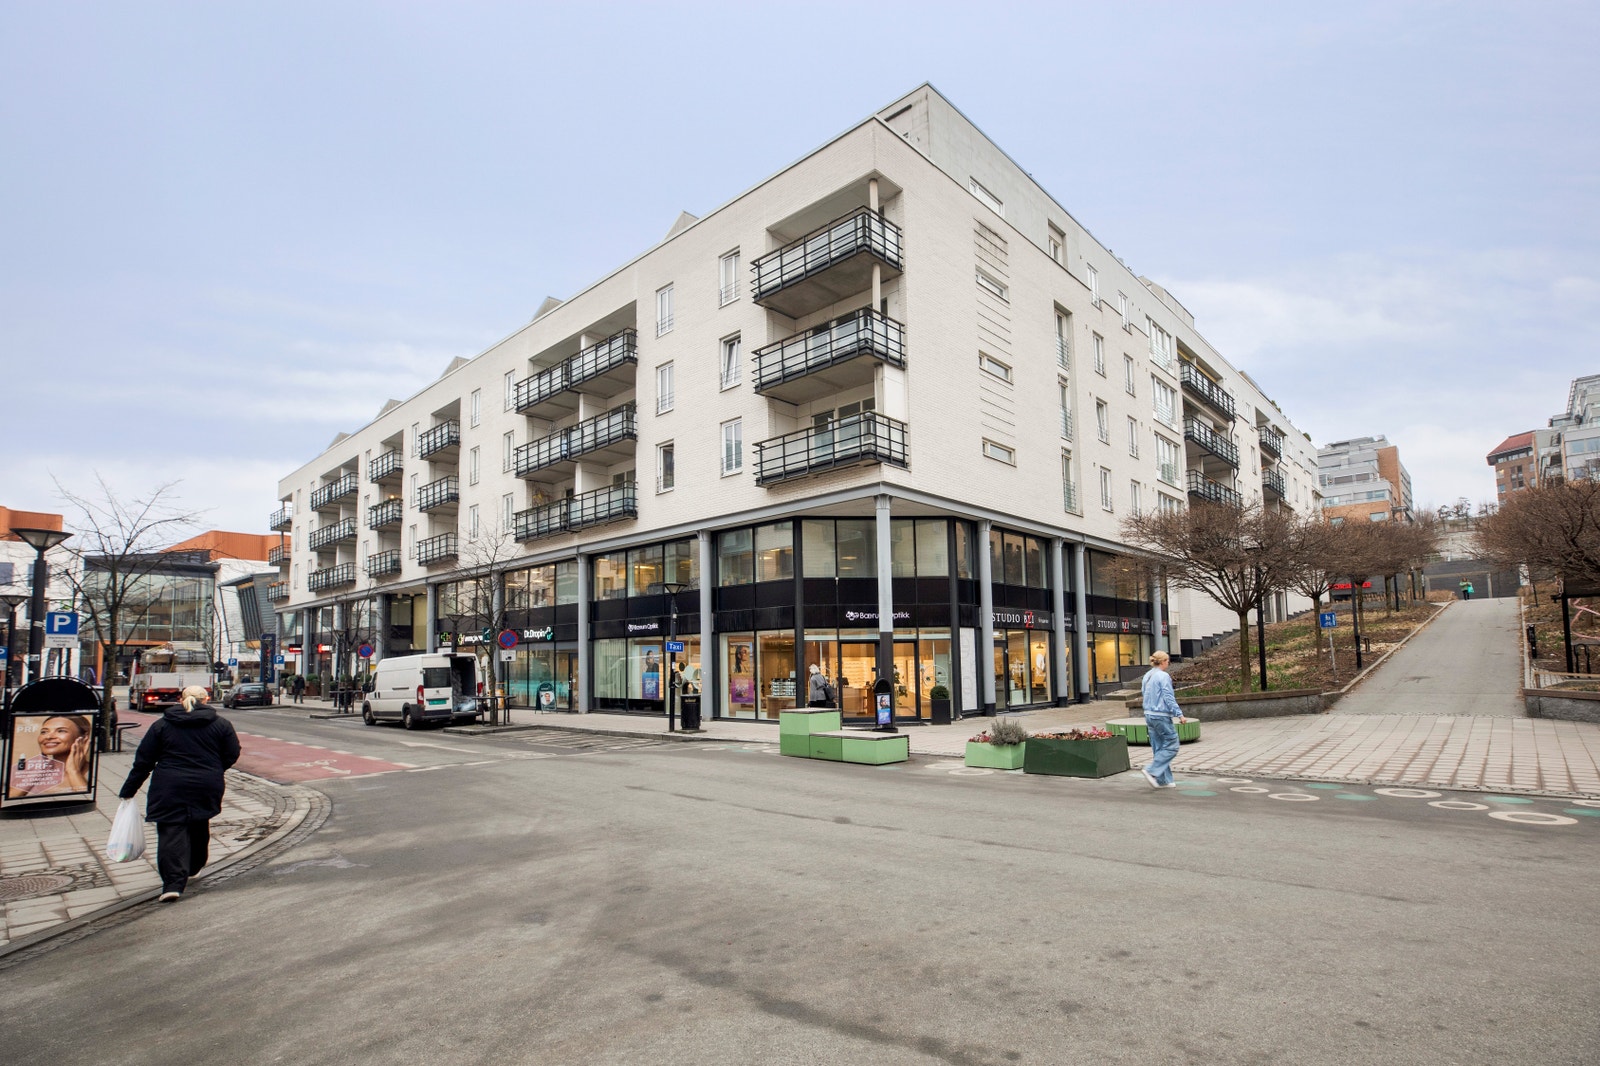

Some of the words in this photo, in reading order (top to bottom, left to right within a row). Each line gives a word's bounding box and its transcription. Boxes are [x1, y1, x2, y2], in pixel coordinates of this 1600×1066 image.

[892, 611, 910, 619] ptikk
[992, 613, 1020, 623] STUDIO
[53, 615, 71, 632] P
[1097, 619, 1117, 629] STUDIO
[16, 723, 39, 733] PRF
